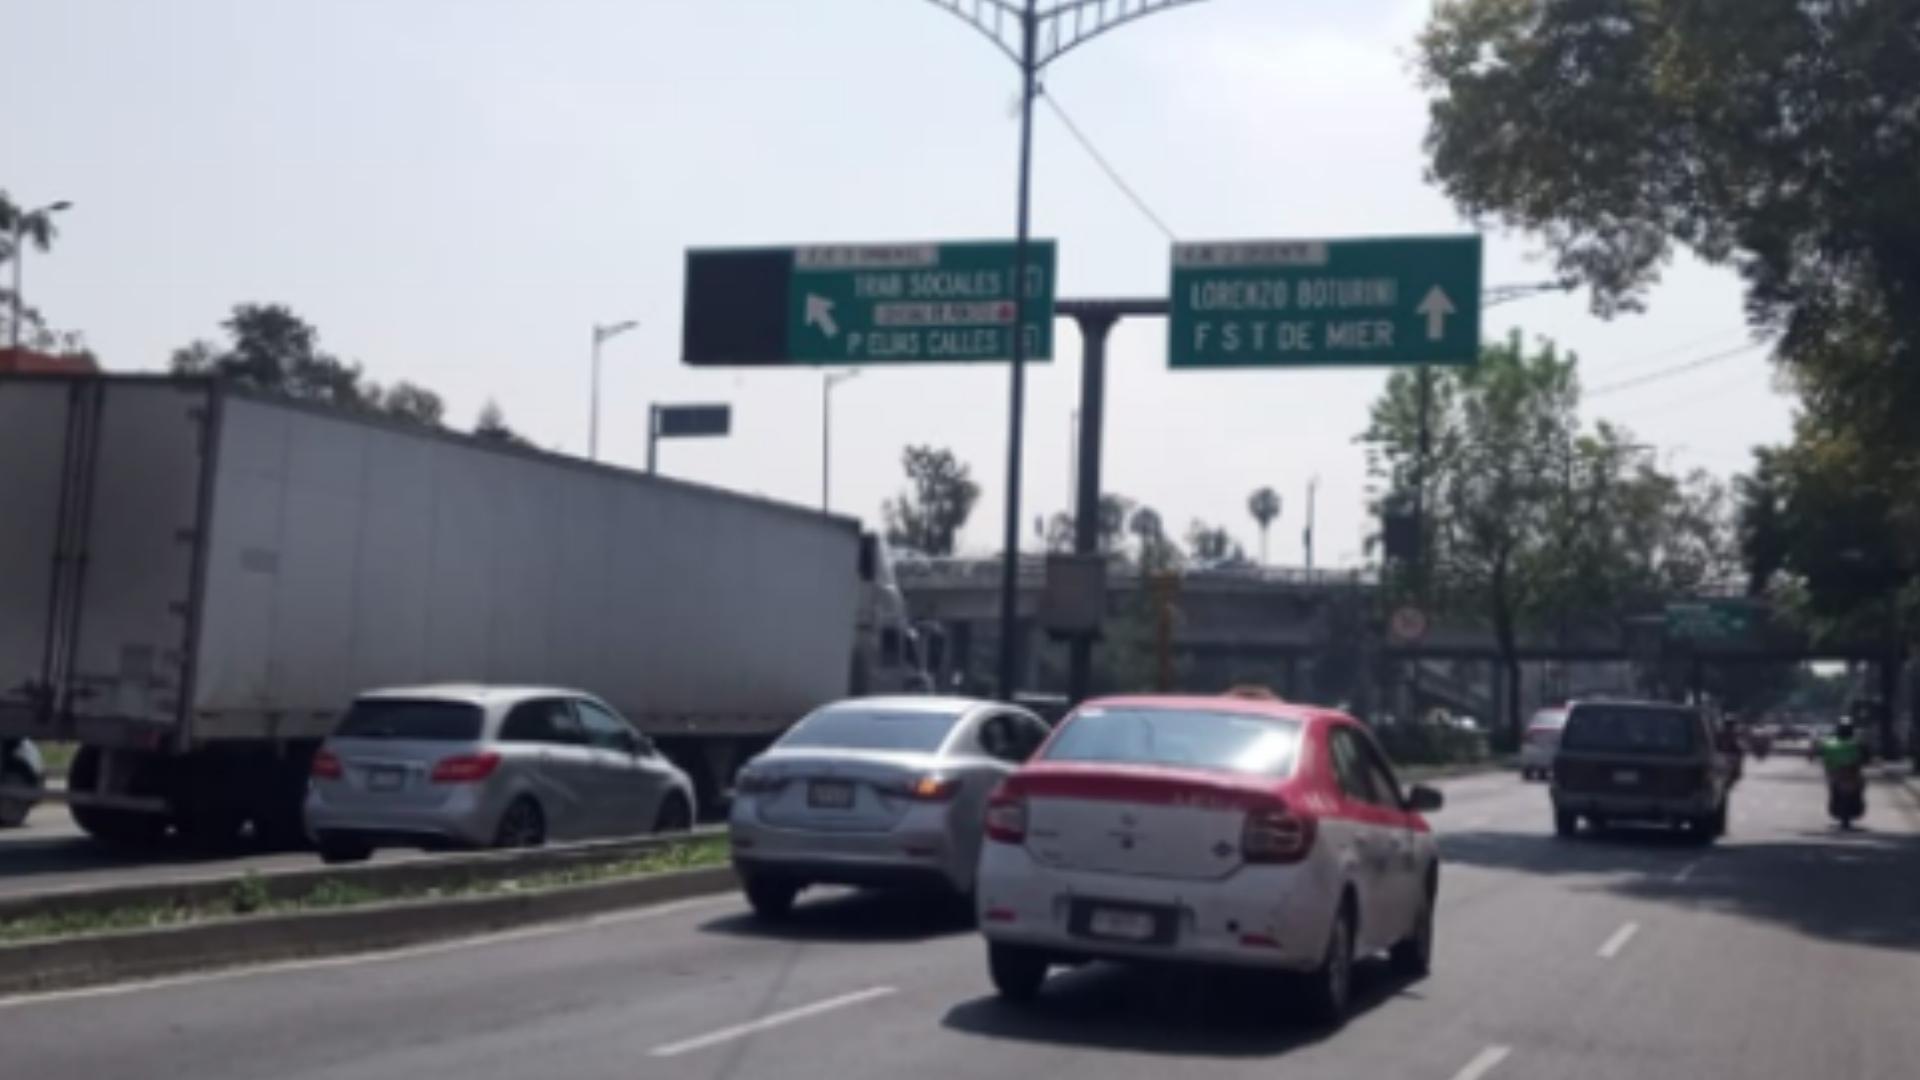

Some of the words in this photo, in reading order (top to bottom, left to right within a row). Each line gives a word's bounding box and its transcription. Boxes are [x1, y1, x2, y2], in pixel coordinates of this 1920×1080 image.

[854, 271, 903, 298] TRAB
[909, 270, 1001, 297] SOCIALES
[1190, 279, 1288, 310] LORENZO
[1297, 277, 1399, 309] BOTURINI
[846, 332, 862, 355] P
[926, 329, 999, 354] CALLES
[1194, 322, 1212, 351] F
[1221, 321, 1240, 351] S
[1249, 321, 1270, 351] T
[1277, 320, 1316, 351] DE
[1325, 319, 1396, 350] MIER
